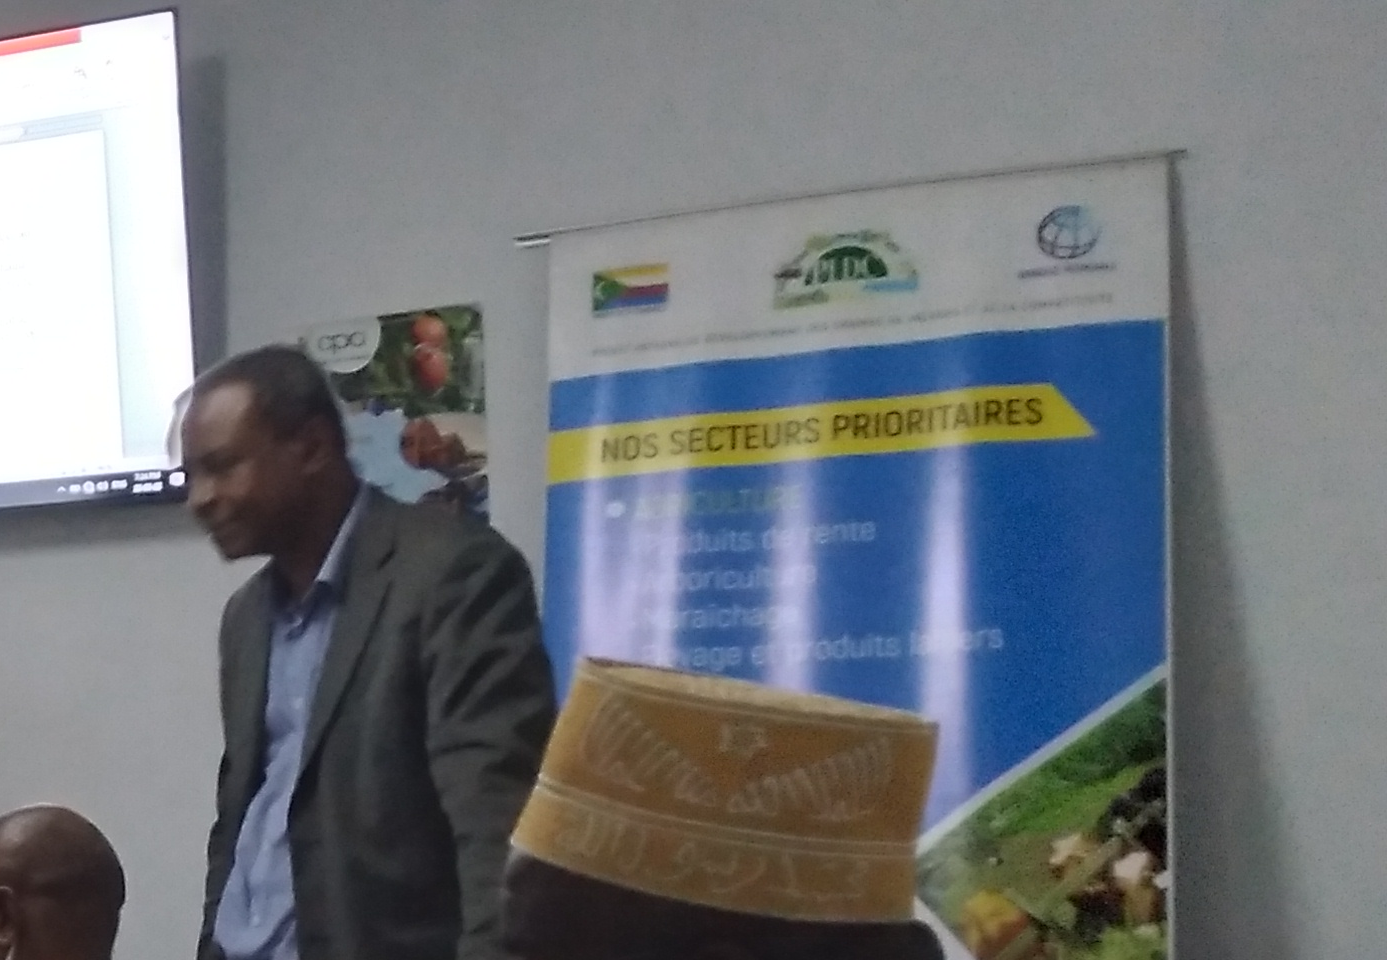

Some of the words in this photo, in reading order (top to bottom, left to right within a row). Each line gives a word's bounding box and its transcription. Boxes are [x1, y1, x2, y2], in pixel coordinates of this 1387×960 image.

[601, 432, 659, 463] NOS
[669, 418, 821, 455] SECTEURS
[832, 397, 1043, 441] PRIORITAIRES
